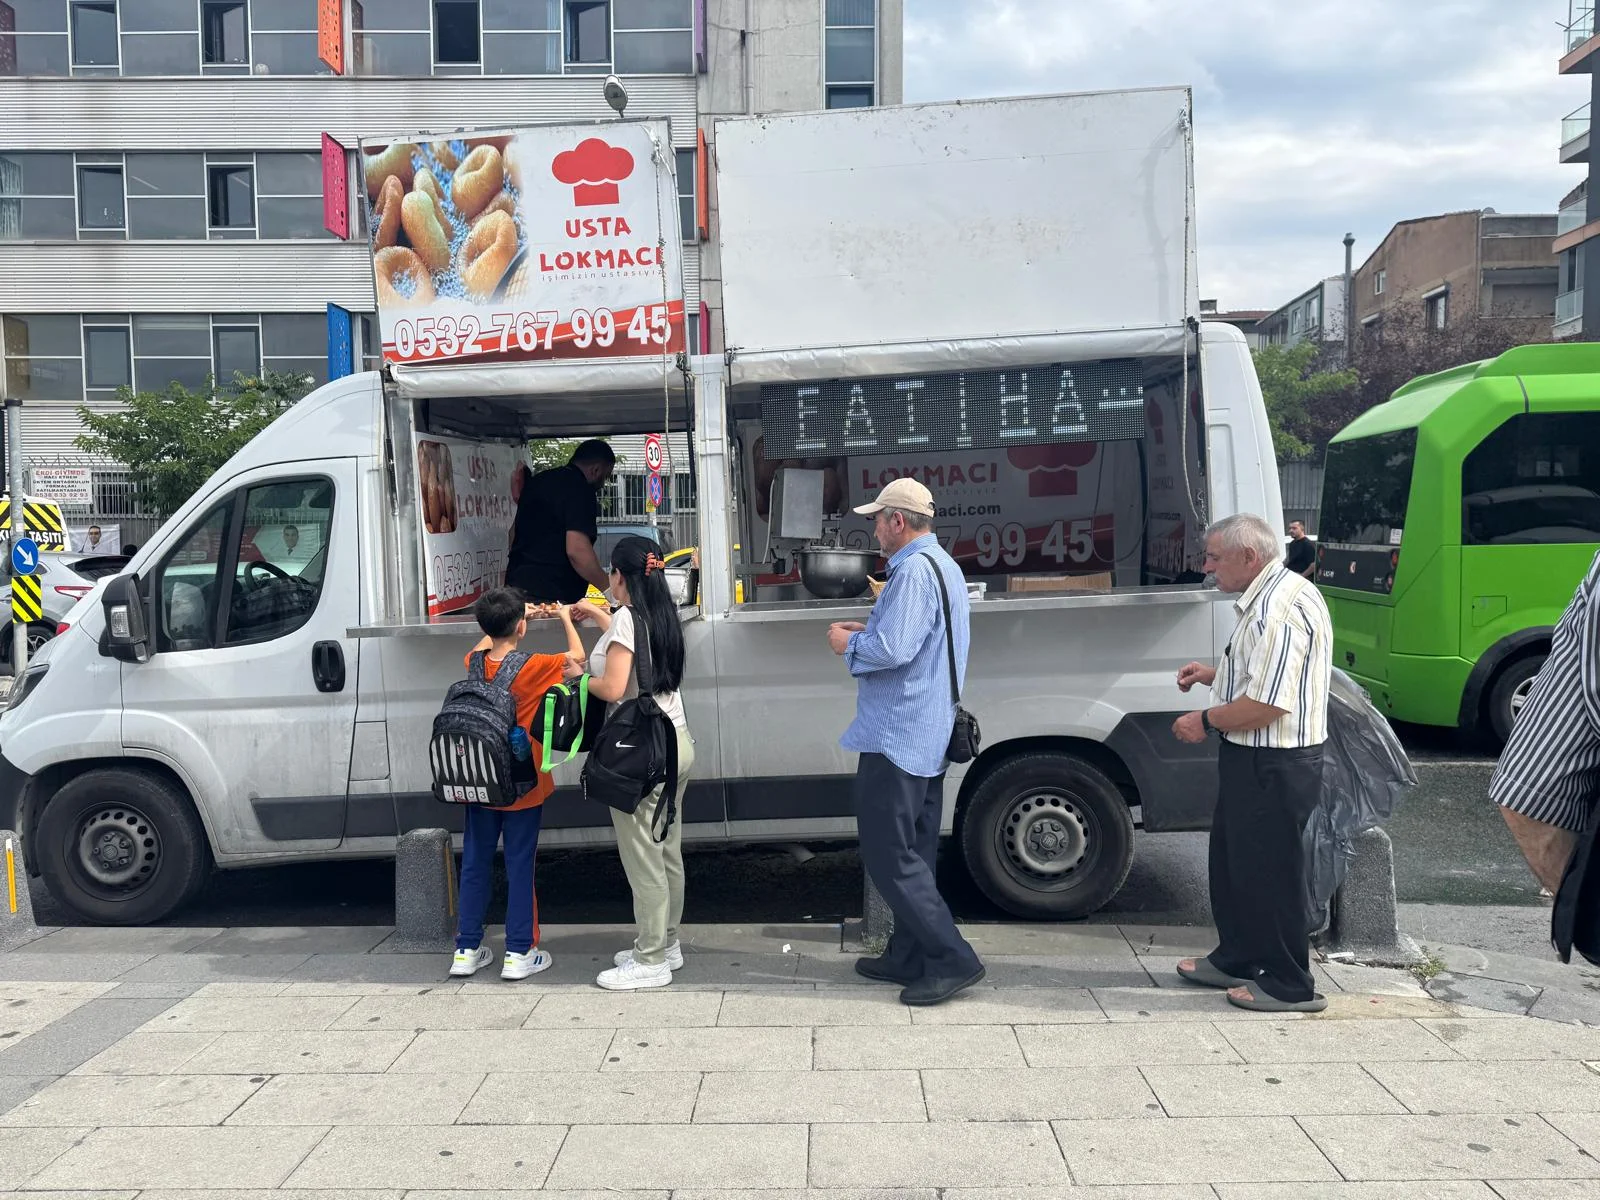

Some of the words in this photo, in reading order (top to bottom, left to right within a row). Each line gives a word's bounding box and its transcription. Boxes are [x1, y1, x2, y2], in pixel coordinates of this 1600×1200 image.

[565, 216, 631, 238] USTA
[539, 246, 664, 272] LOKMACI
[394, 315, 482, 358] 0532
[492, 310, 559, 353] 767
[570, 307, 616, 347] 99
[627, 305, 672, 345] 45
[648, 446, 660, 462] 30
[467, 455, 498, 480] USTA
[862, 462, 998, 489] LOKMACI
[29, 531, 62, 545] TAŞITI
[975, 521, 1027, 568] 99
[1040, 519, 1094, 565] 45
[433, 551, 475, 602] 0532
